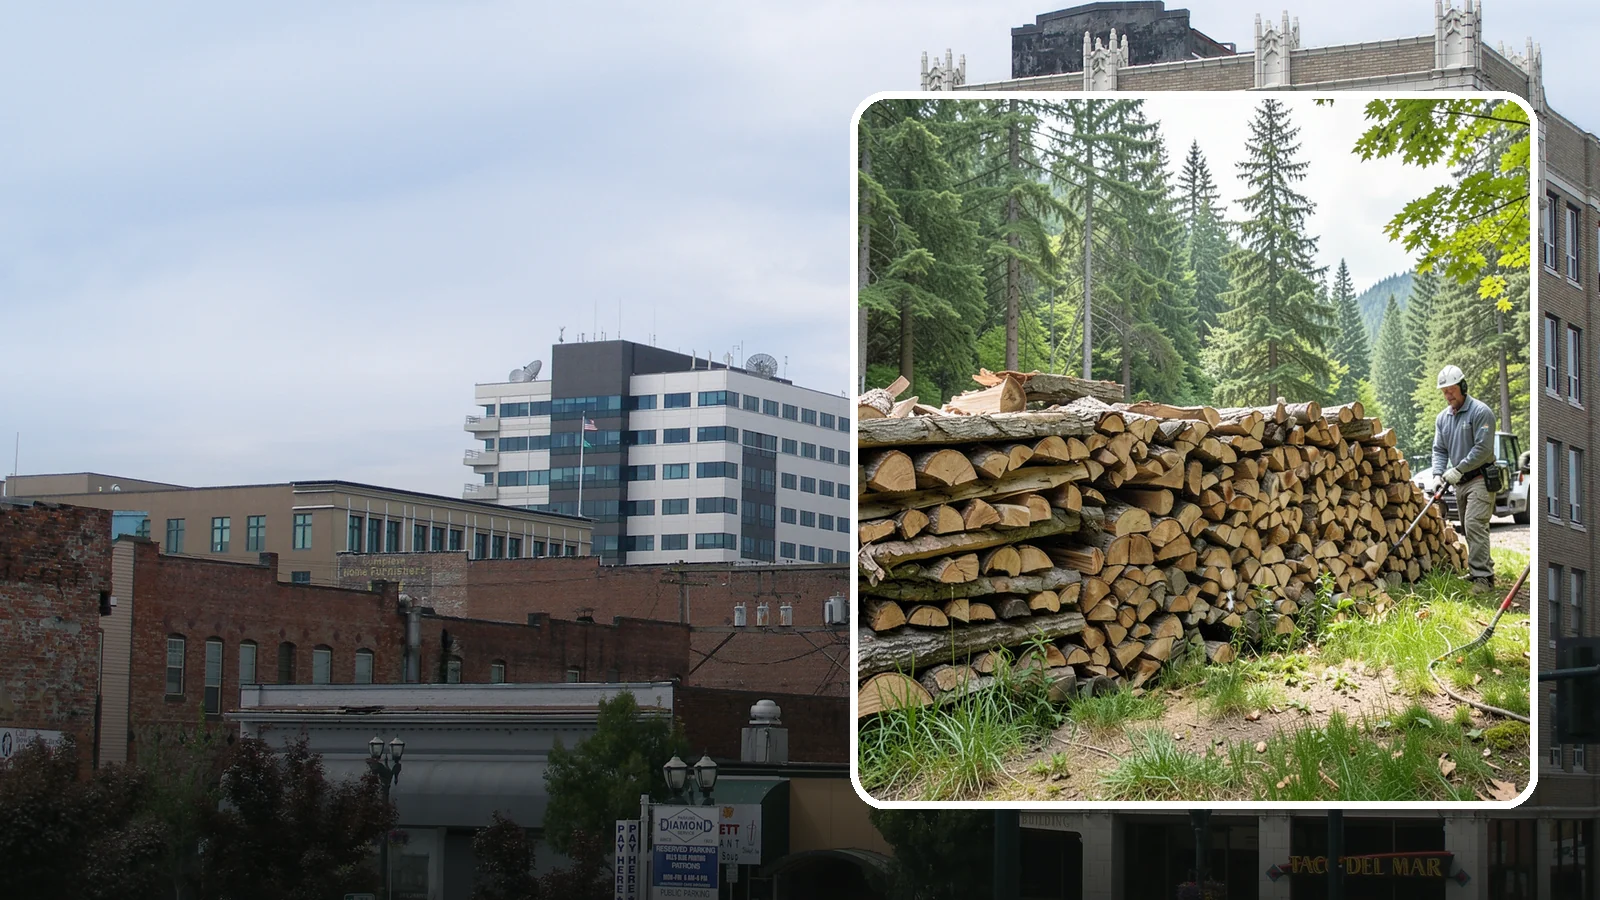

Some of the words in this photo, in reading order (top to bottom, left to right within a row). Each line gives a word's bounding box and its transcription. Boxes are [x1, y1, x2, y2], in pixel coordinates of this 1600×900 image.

[343, 567, 368, 577] Home
[370, 566, 427, 576] Furnishers
[660, 818, 713, 833] DIAMOND
[1022, 814, 1070, 828] BUILDING
[617, 825, 625, 852] PAY
[628, 824, 637, 852] PAY
[656, 845, 688, 853] RESERVED
[689, 846, 716, 854] PARKING
[721, 851, 739, 863] Soup
[671, 862, 701, 870] PATRONS
[1346, 856, 1385, 876] DEL
[1392, 857, 1442, 877] MAR
[616, 855, 625, 894] HERE
[627, 855, 636, 893] HERE
[660, 888, 682, 897] PUBLIC
[683, 889, 710, 898] PARKING
